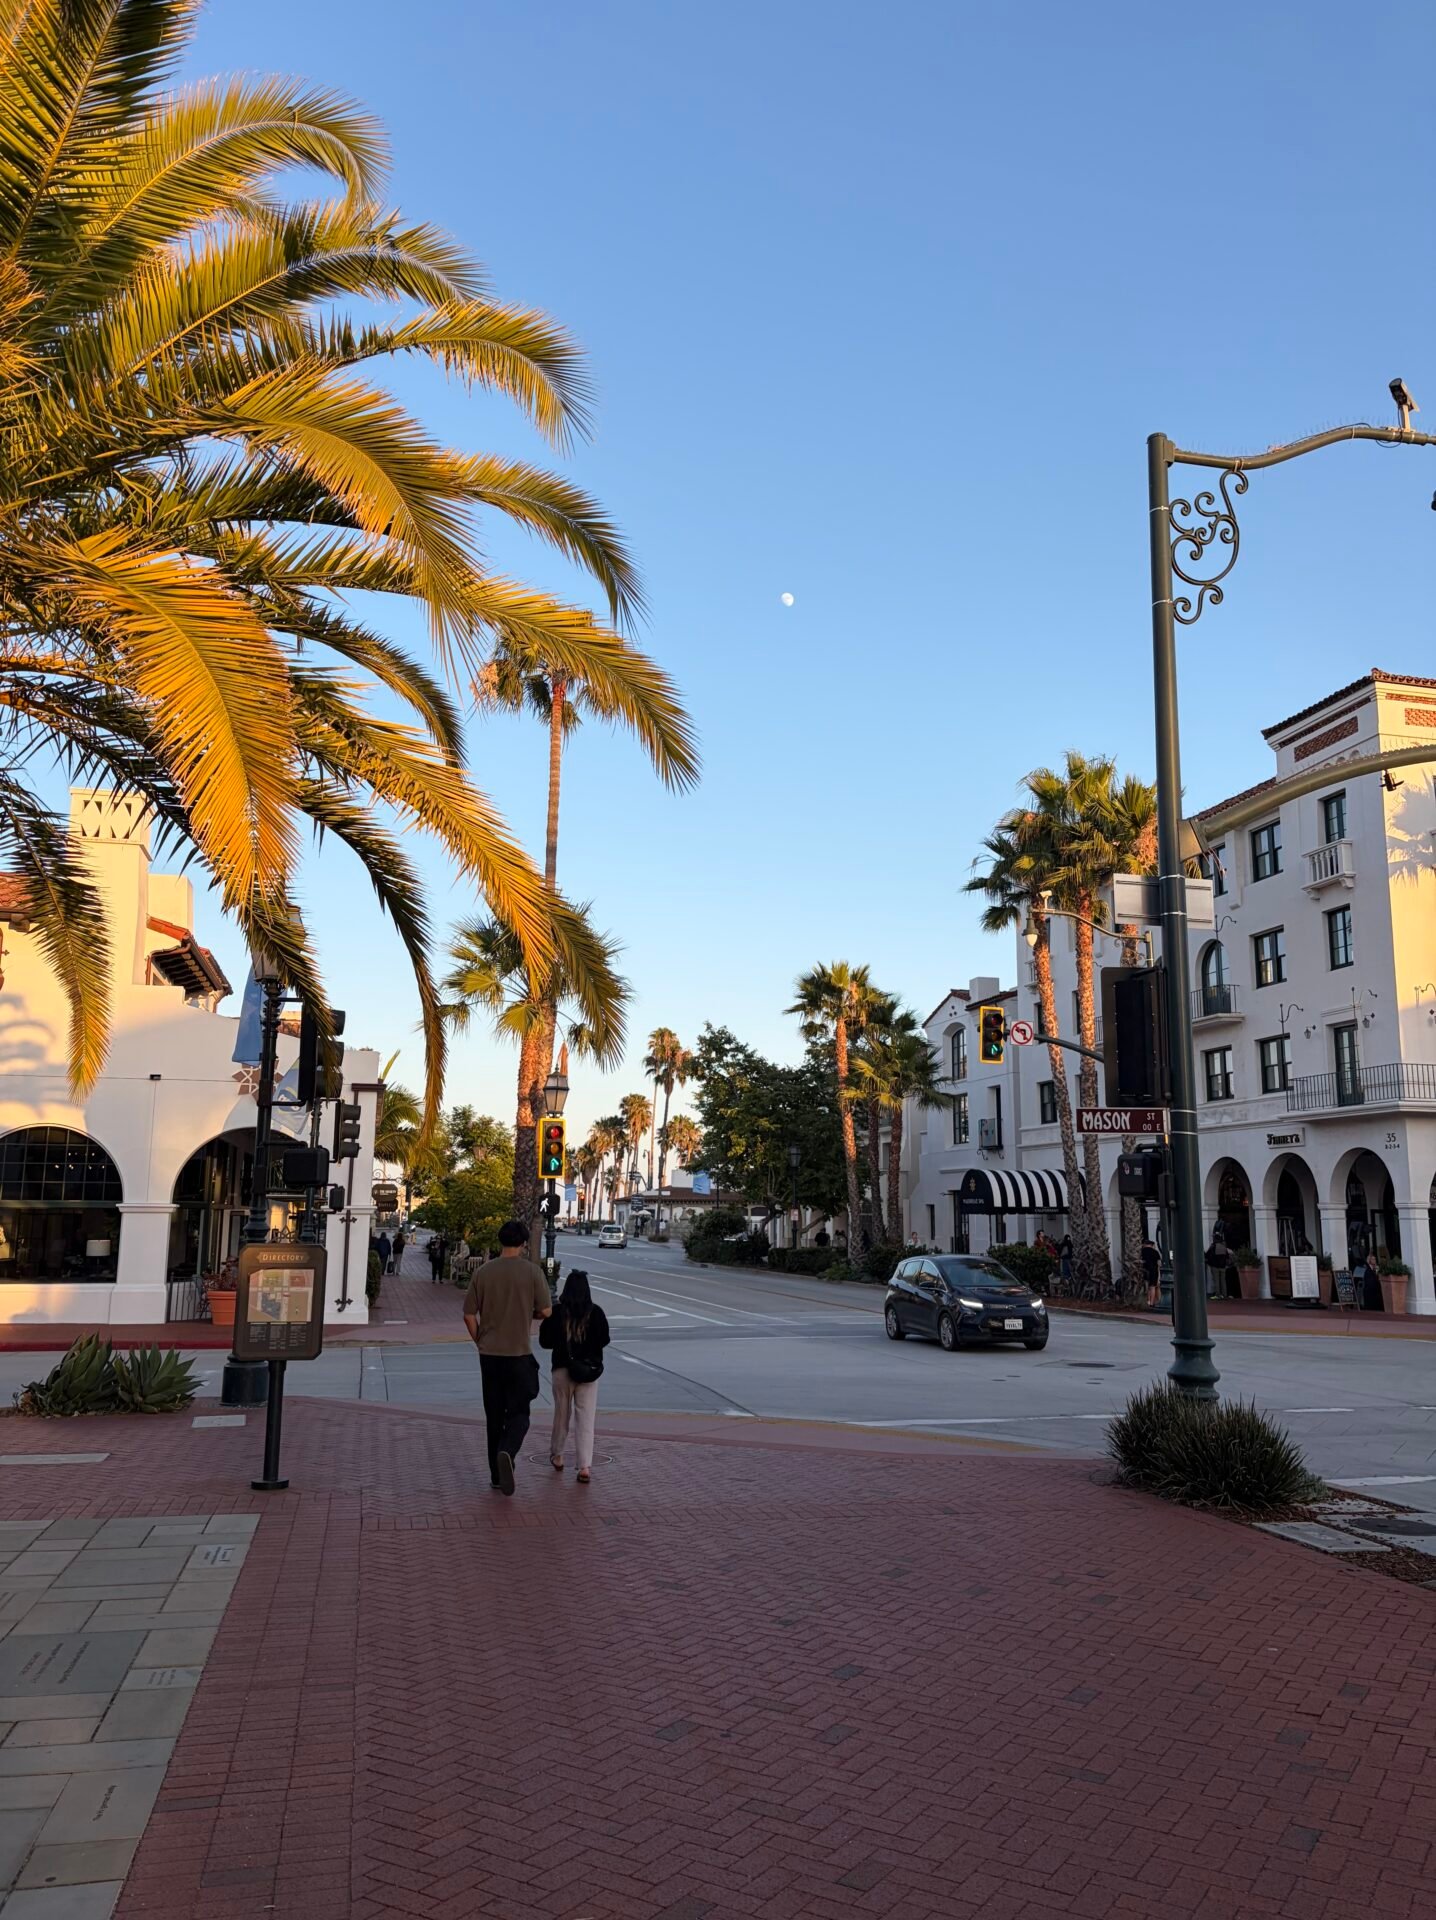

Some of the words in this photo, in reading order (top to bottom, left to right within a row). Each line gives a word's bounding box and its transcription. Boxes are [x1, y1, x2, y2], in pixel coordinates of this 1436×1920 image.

[1082, 1112, 1131, 1130] MASON
[1146, 1112, 1156, 1120] ST
[1142, 1123, 1152, 1131] 00
[1156, 1123, 1161, 1131] E
[1385, 1132, 1396, 1142] 35
[262, 1253, 304, 1261] DIRECTORY
